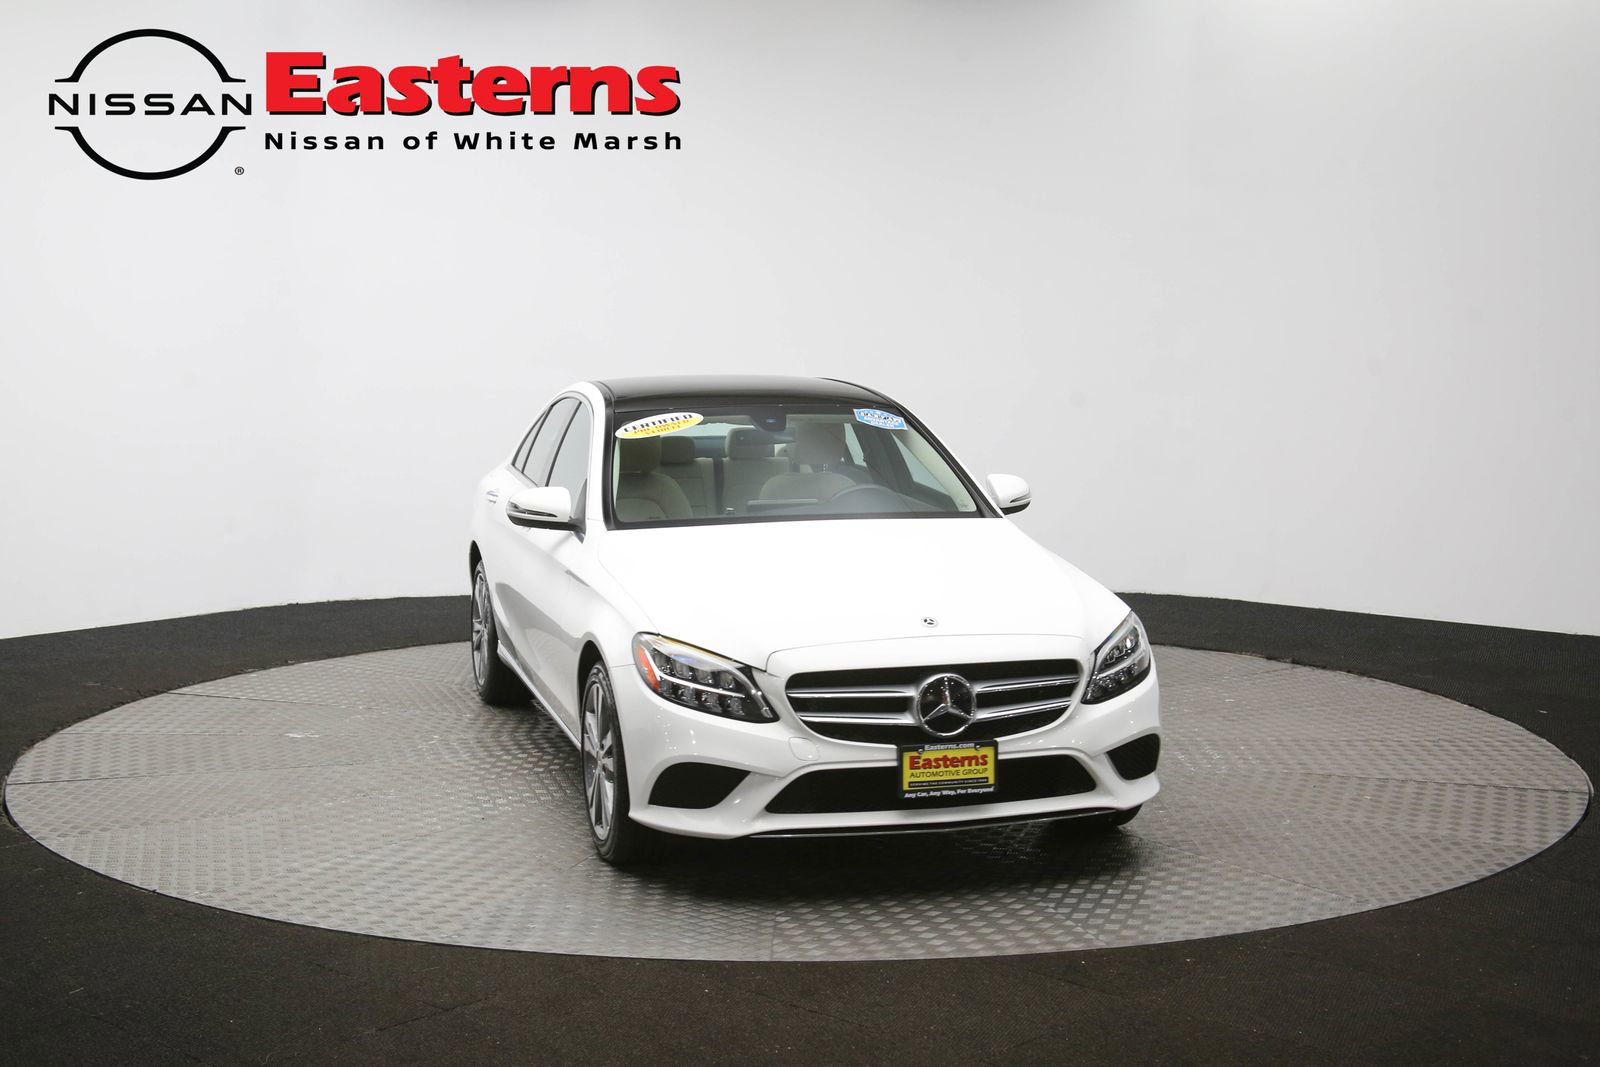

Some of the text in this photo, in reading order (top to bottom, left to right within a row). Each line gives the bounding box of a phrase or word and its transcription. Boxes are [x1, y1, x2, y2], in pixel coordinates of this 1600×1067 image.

[925, 743, 975, 751] Easterns.com
[909, 754, 988, 770] Easterns
[909, 770, 960, 778] AUTOMOTIVE
